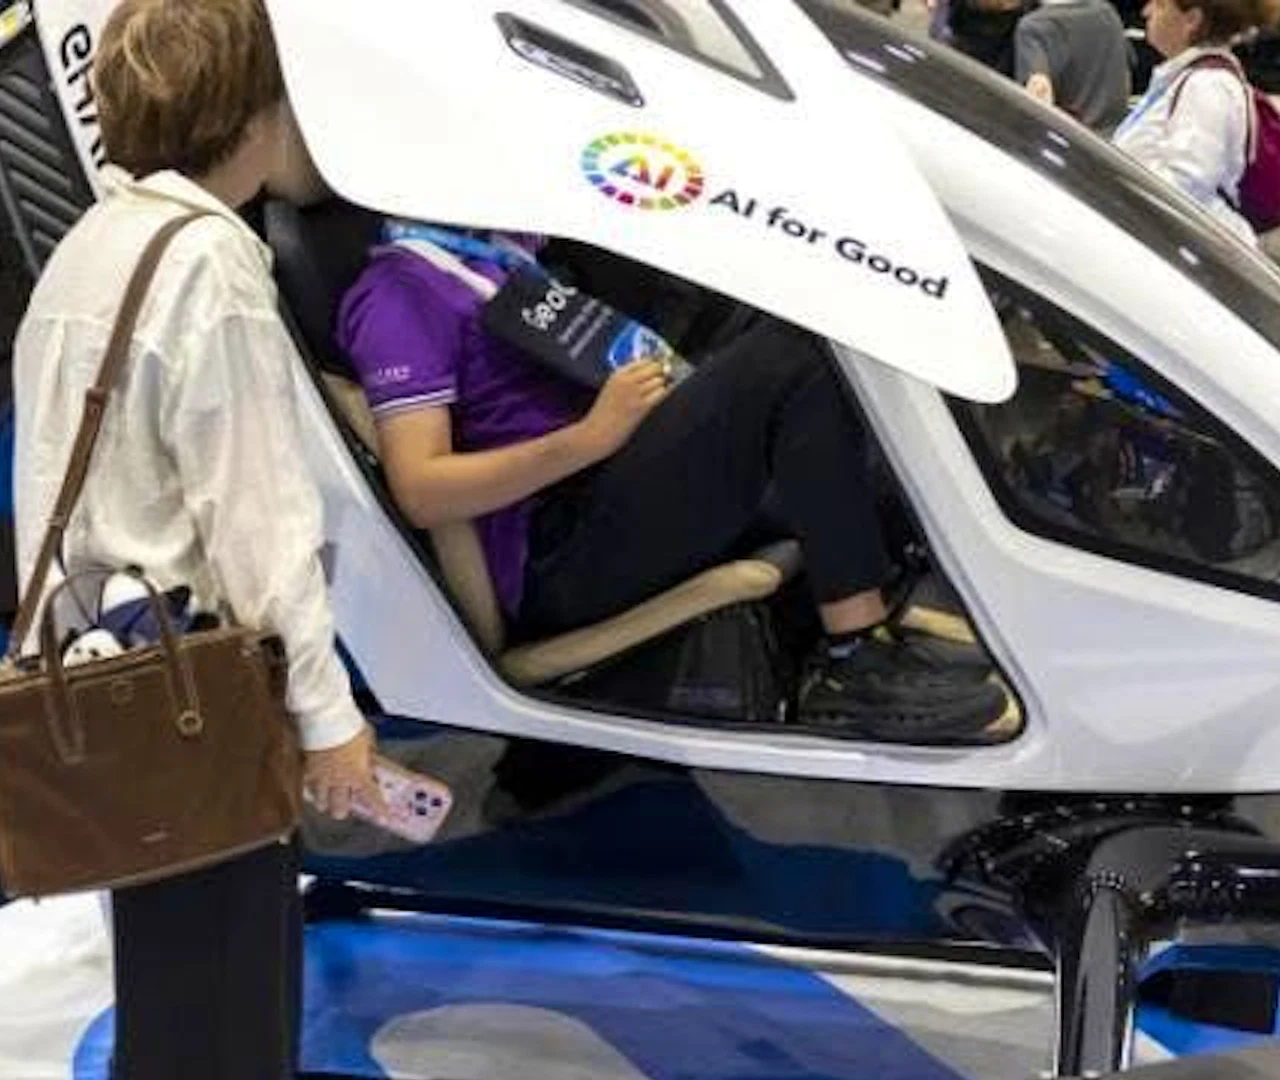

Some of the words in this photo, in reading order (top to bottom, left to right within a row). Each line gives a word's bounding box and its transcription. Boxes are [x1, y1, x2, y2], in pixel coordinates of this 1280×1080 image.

[608, 153, 675, 191] AI
[709, 188, 758, 219] AI
[767, 206, 827, 245] for
[834, 236, 950, 300] Good
